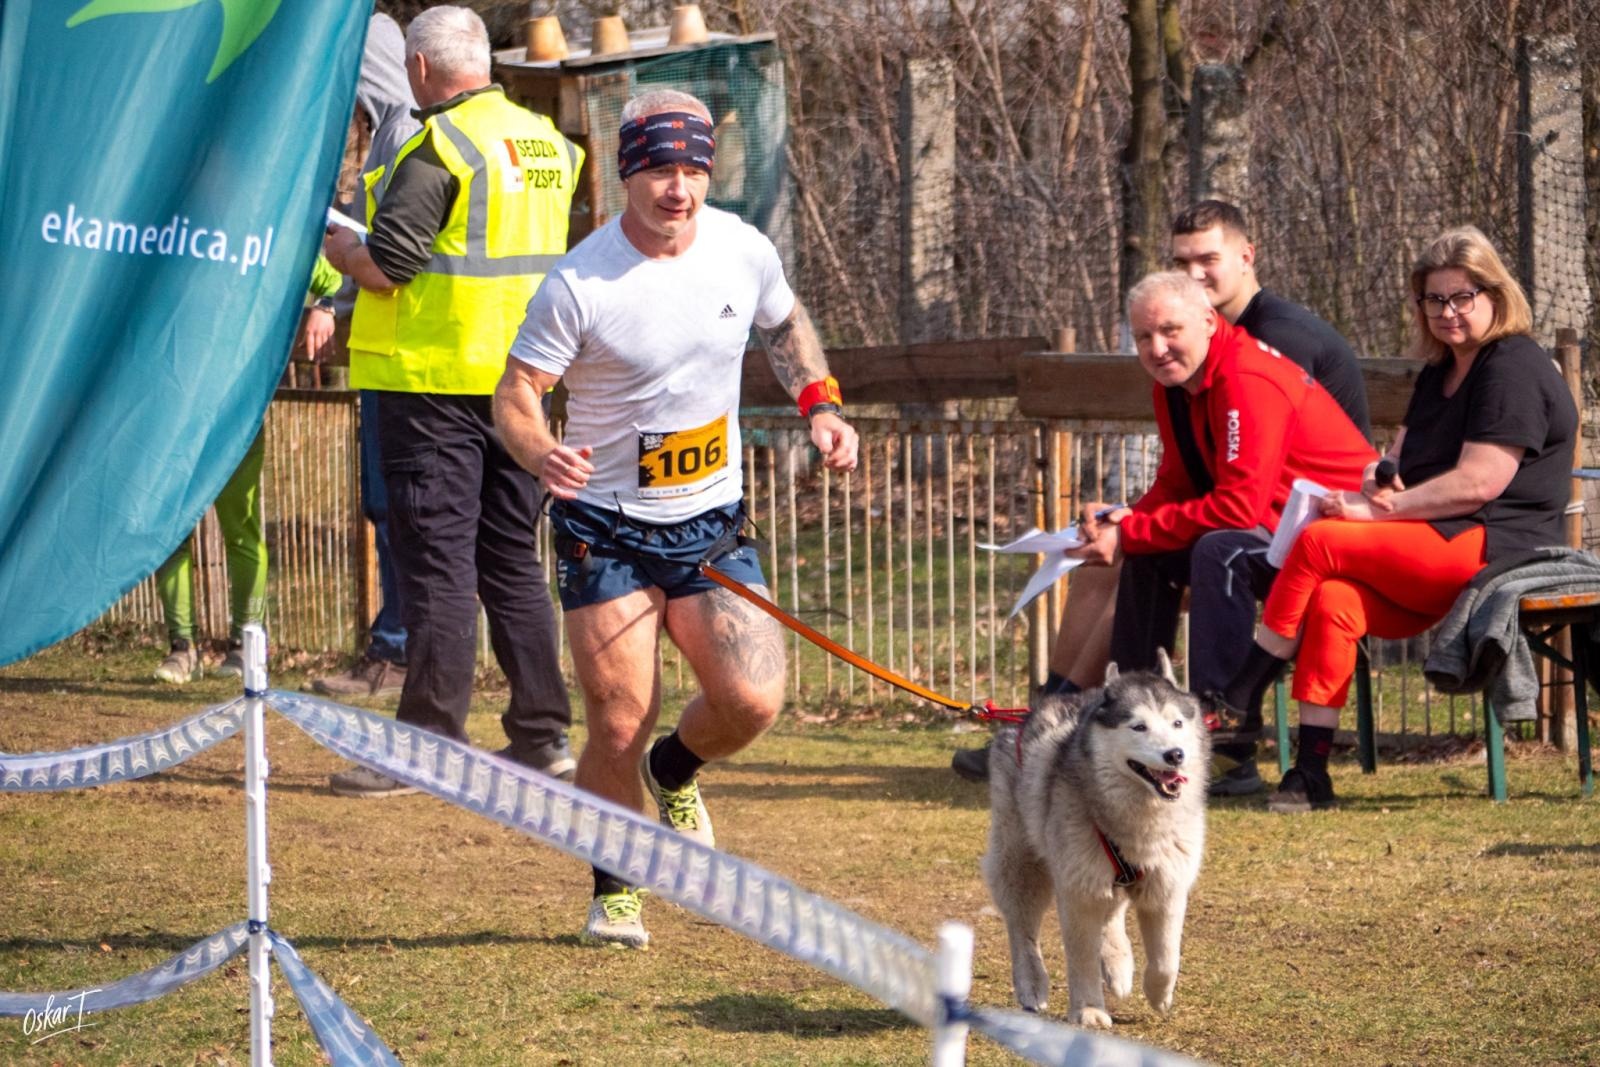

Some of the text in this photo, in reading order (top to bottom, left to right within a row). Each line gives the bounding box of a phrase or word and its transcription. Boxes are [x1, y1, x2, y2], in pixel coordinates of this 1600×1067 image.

[527, 169, 563, 189] PZSPZ
[41, 203, 274, 275] ekamedica.pl
[658, 436, 721, 478] 106
[1227, 409, 1240, 462] POLSKA
